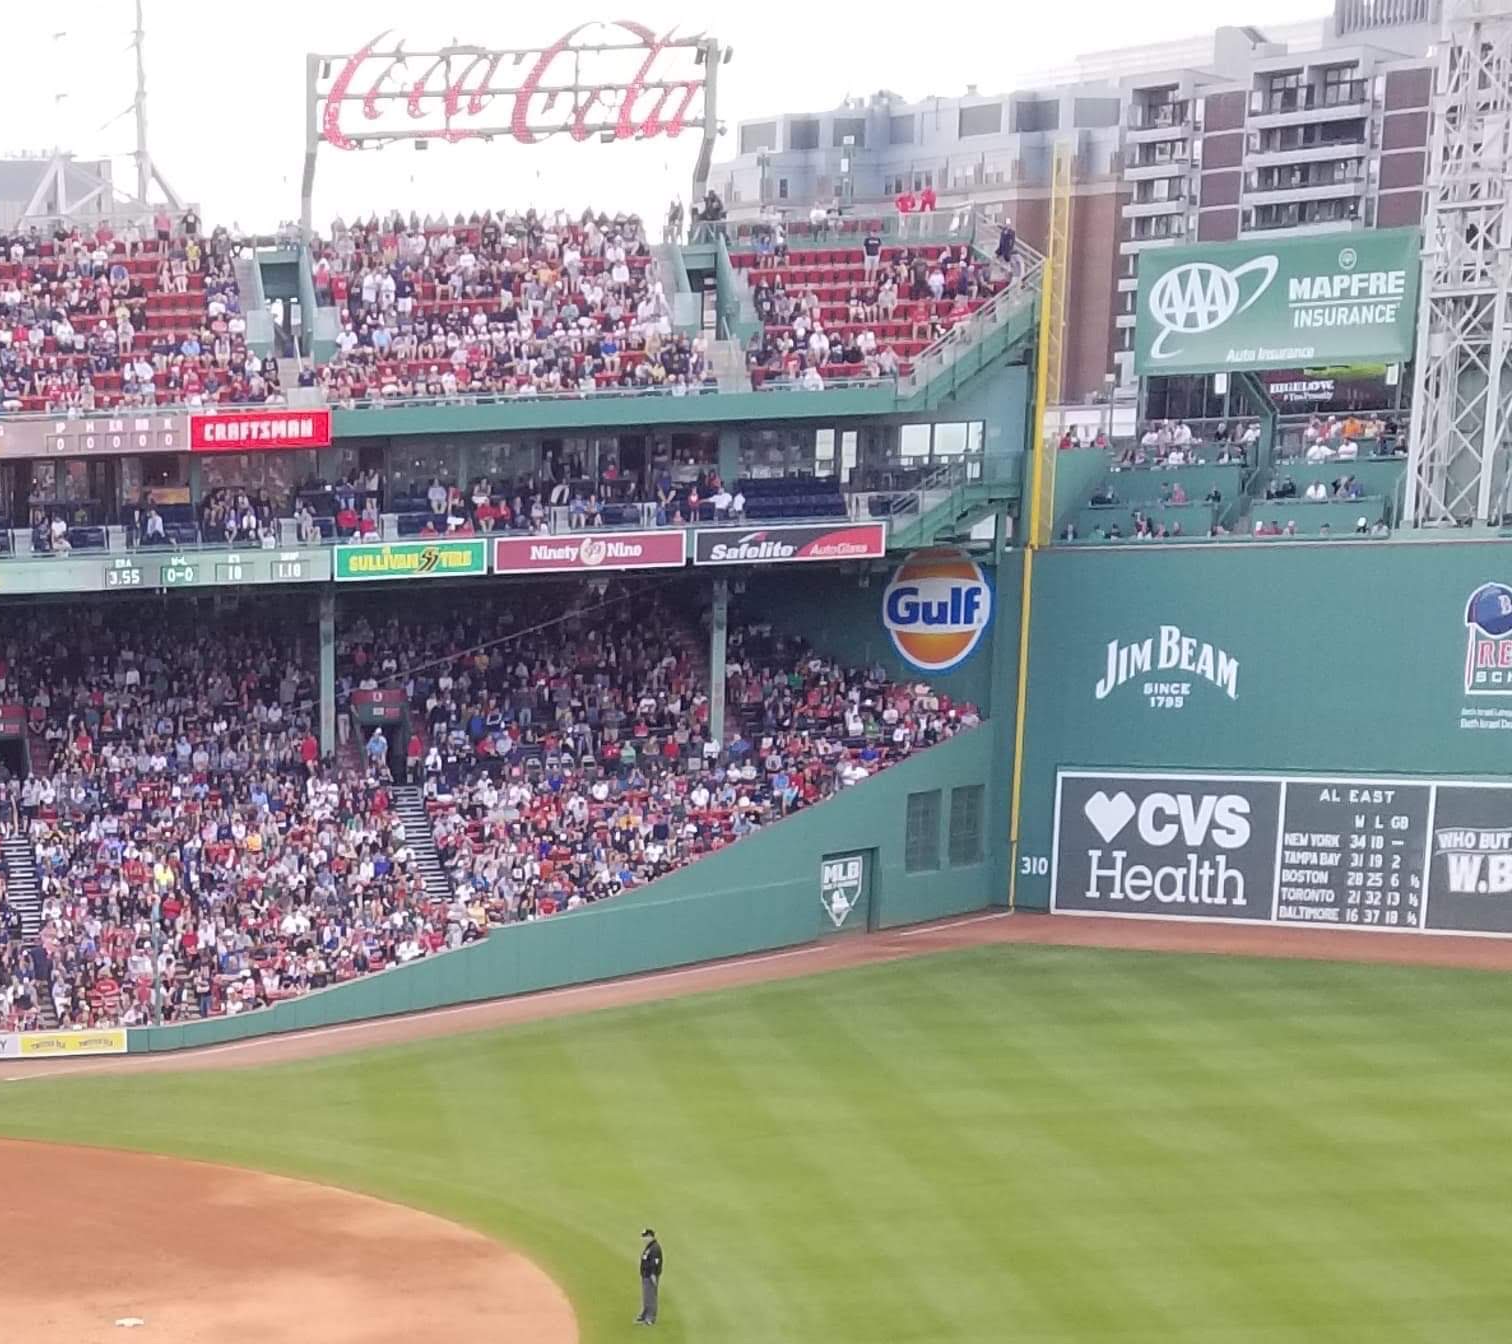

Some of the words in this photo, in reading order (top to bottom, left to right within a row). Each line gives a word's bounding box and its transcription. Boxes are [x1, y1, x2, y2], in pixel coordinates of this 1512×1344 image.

[1289, 271, 1405, 300] MAPFRE
[1160, 264, 1230, 331] AAA
[1293, 304, 1397, 328] INSURANCE
[1226, 348, 1256, 362] Auto
[1257, 346, 1315, 361] Insurance
[204, 418, 313, 442] CRAFTSMAN
[530, 546, 579, 562] Ninety
[606, 542, 643, 558] Nine
[711, 541, 794, 560] Safelite
[887, 586, 982, 625] Gulf
[1095, 638, 1153, 699] JIM
[1158, 625, 1239, 700] BEAM
[1144, 682, 1191, 695] SINCE
[1320, 788, 1341, 802] AL
[1349, 789, 1395, 803] EAST
[1138, 791, 1251, 849] CVS
[1354, 815, 1365, 828] W
[1375, 815, 1384, 829] L
[1284, 833, 1308, 847] NEW
[1311, 833, 1340, 848] YORK
[1350, 834, 1366, 849] 34
[1438, 831, 1477, 849] WHO
[1479, 831, 1512, 849] BUT
[1021, 857, 1048, 875] 310
[1284, 850, 1318, 865] TAMPA
[1319, 852, 1342, 866] BAY
[1350, 853, 1364, 867] 31
[1392, 854, 1401, 869] 2
[823, 861, 859, 883] MLB
[1085, 849, 1247, 905] Health
[1282, 868, 1328, 884] BOSTON
[1366, 872, 1384, 887] 25
[1390, 873, 1399, 887] 6
[1280, 887, 1335, 903] TORONTO
[1348, 890, 1361, 904] 21
[1365, 891, 1382, 905] 32
[1387, 891, 1400, 906] 13
[1279, 905, 1340, 921] BALTIMORE
[1346, 908, 1359, 922] 16
[1363, 909, 1380, 923] 37
